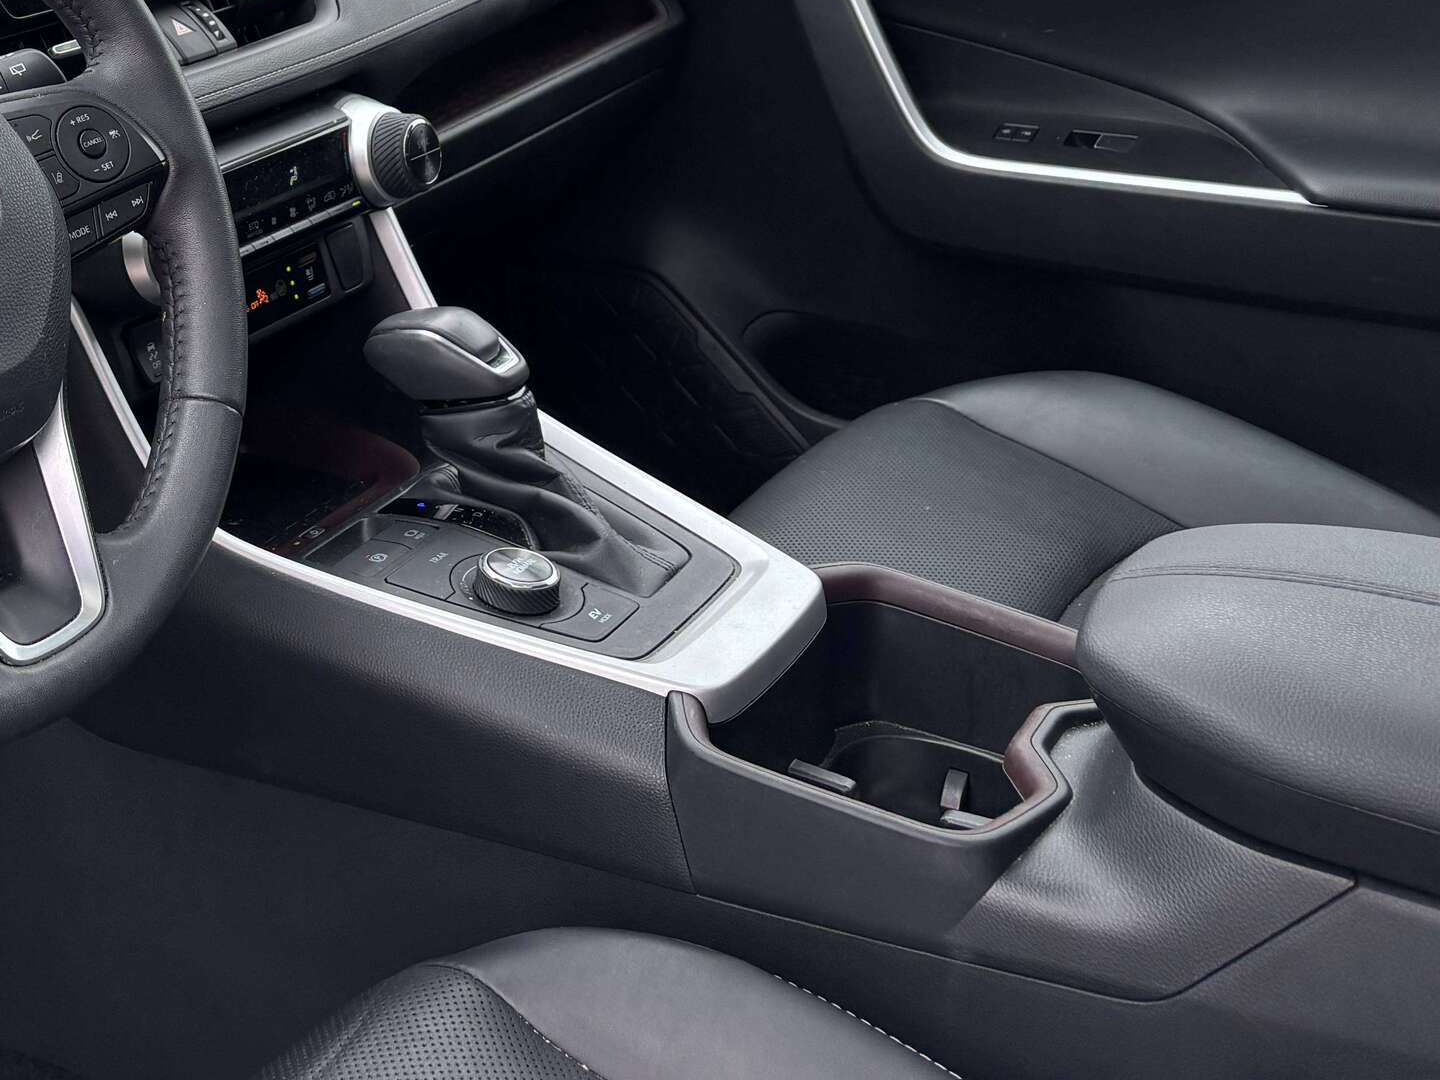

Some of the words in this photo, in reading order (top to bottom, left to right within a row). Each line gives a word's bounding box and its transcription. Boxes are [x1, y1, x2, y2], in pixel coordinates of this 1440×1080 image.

[83, 136, 105, 148] CANCEL
[68, 225, 91, 240] MODE
[588, 608, 602, 619] EV
